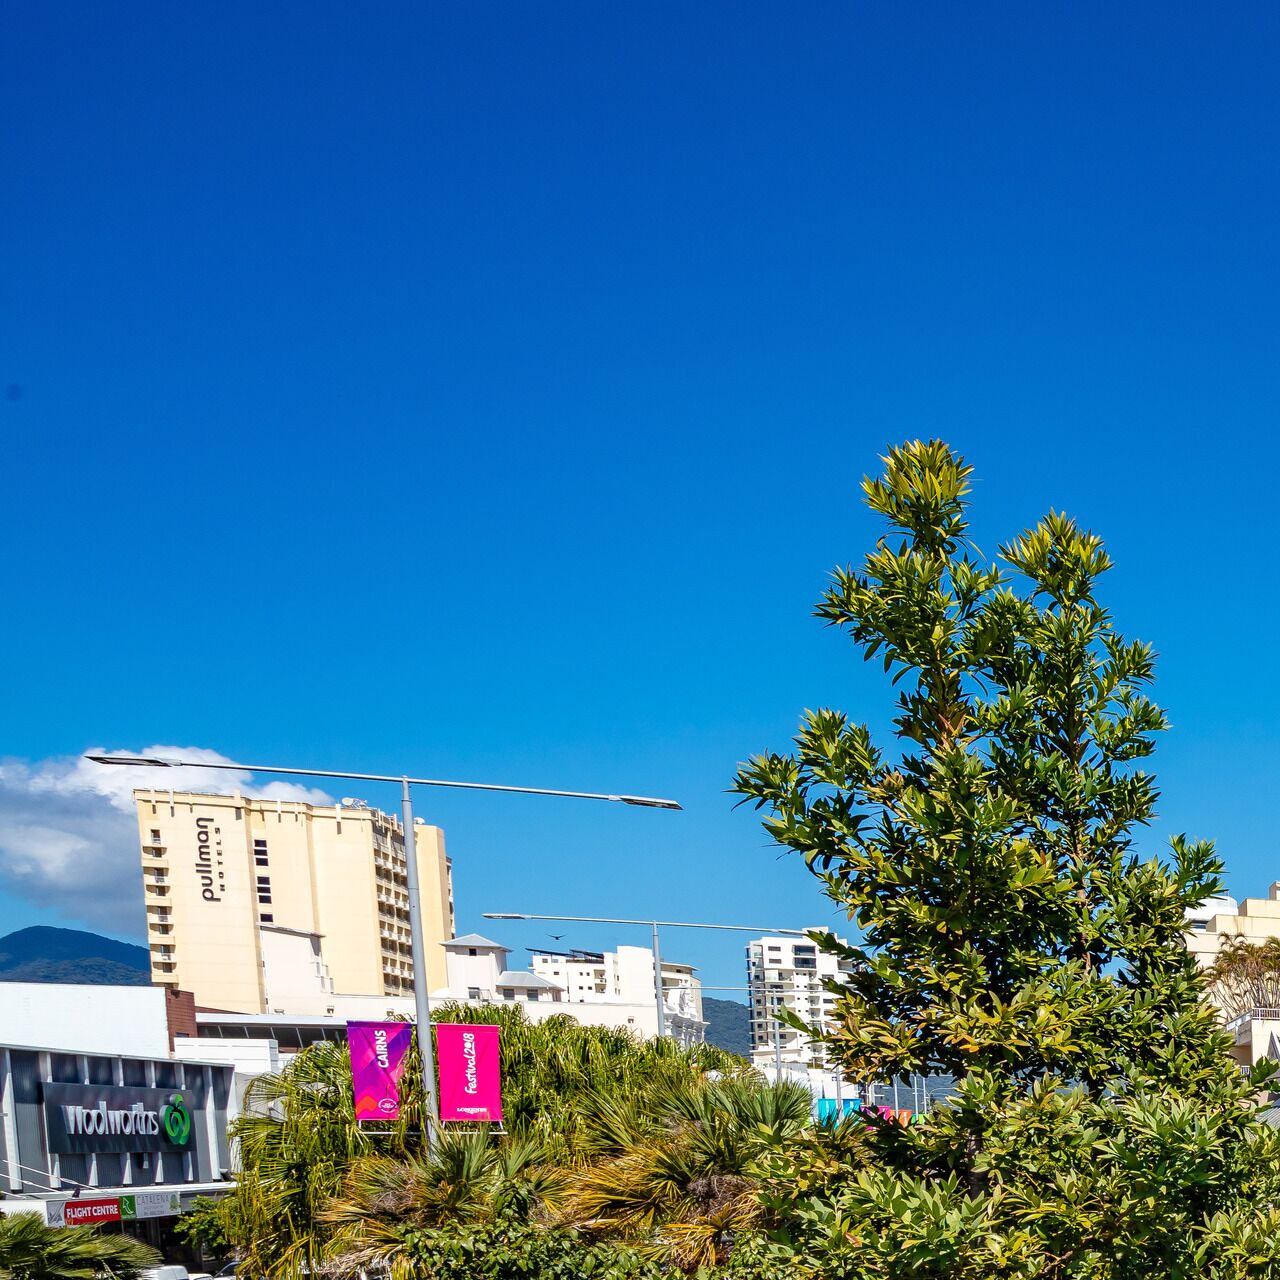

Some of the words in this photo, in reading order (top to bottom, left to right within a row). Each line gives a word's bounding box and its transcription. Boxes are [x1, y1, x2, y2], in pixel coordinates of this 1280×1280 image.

[195, 817, 221, 902] pullman
[214, 827, 226, 892] HOTELS
[374, 1029, 390, 1069] CAIRNS
[61, 1100, 160, 1136] Woolworths
[66, 1206, 92, 1219] FLIGHT
[92, 1205, 118, 1217] CENTRE
